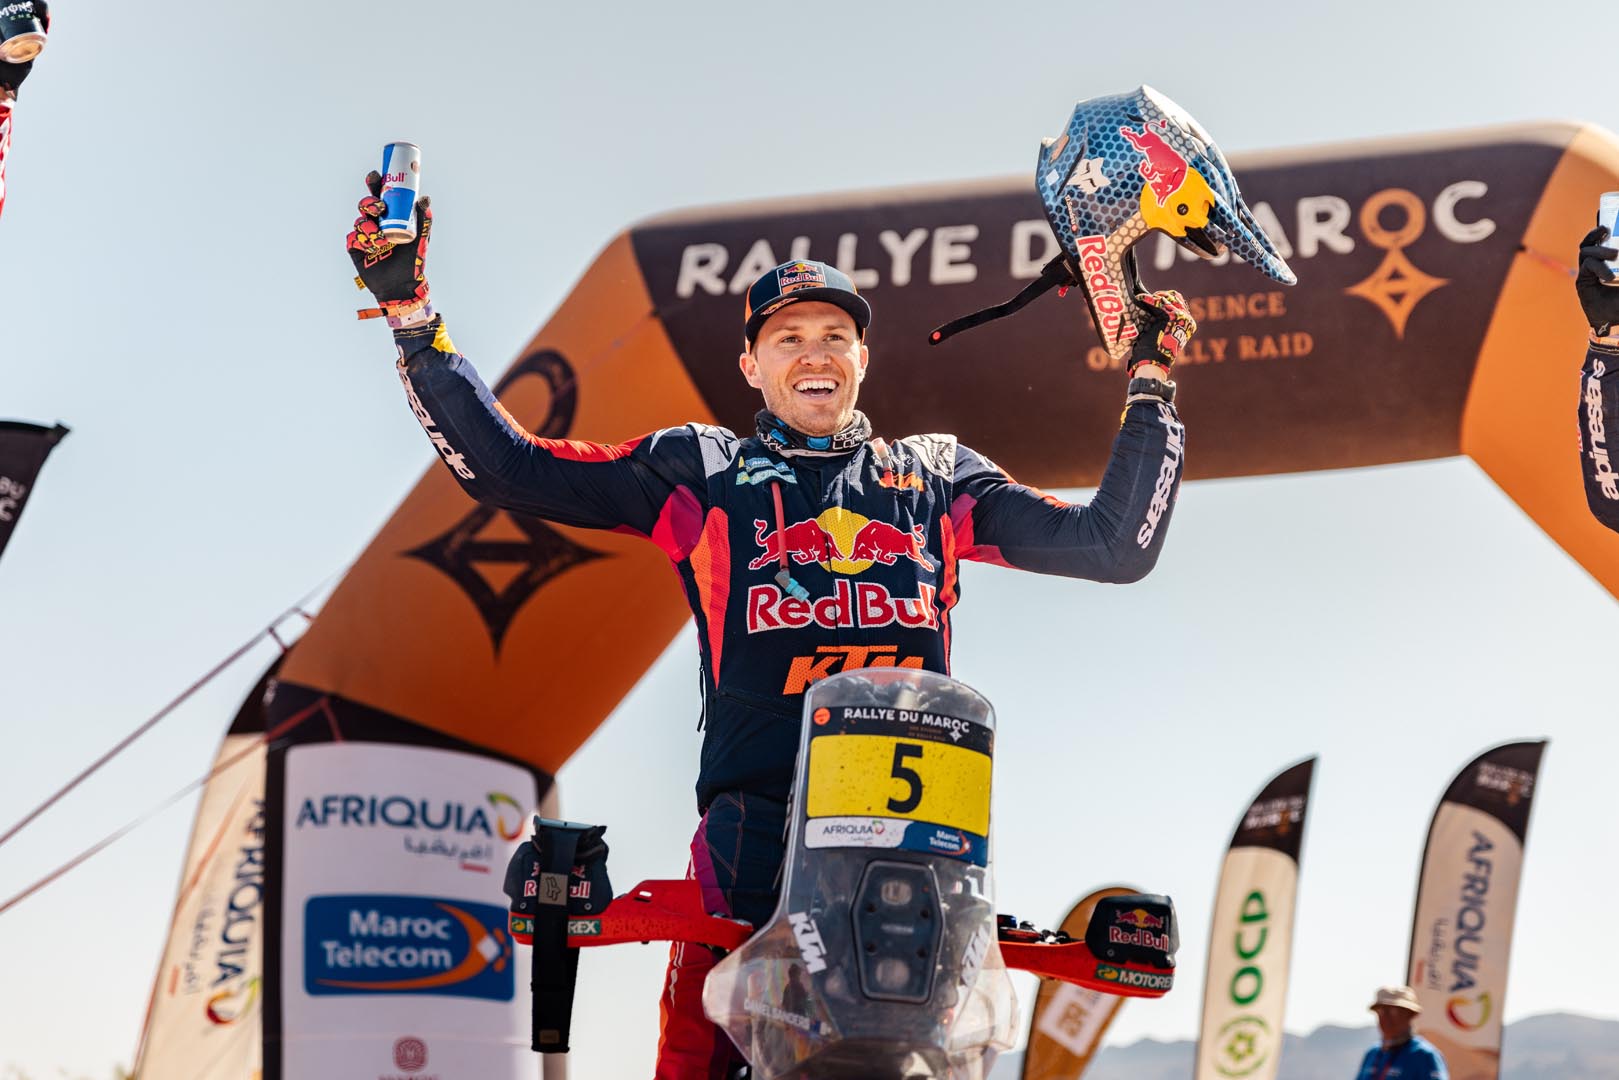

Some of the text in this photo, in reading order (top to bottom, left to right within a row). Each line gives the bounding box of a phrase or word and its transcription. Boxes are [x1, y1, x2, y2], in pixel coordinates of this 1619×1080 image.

[781, 273, 803, 287] Red
[1075, 235, 1124, 295] Red
[1237, 331, 1314, 361] RAID
[747, 578, 854, 635] Red
[844, 707, 895, 721] RALLYE
[900, 710, 919, 723] DU
[921, 713, 970, 734] MAROC
[886, 742, 924, 814] 5
[296, 795, 493, 837] AFRIQUIA
[822, 824, 873, 835] AFRIQUIA
[349, 909, 452, 941] Maroc
[1450, 831, 1494, 993] AFRIQUIA
[321, 940, 453, 969] Telecom
[788, 911, 828, 975] KTM
[1108, 925, 1170, 953] Red Bull
[1228, 890, 1269, 1006] OCP
[1118, 970, 1174, 990] MOTORE
